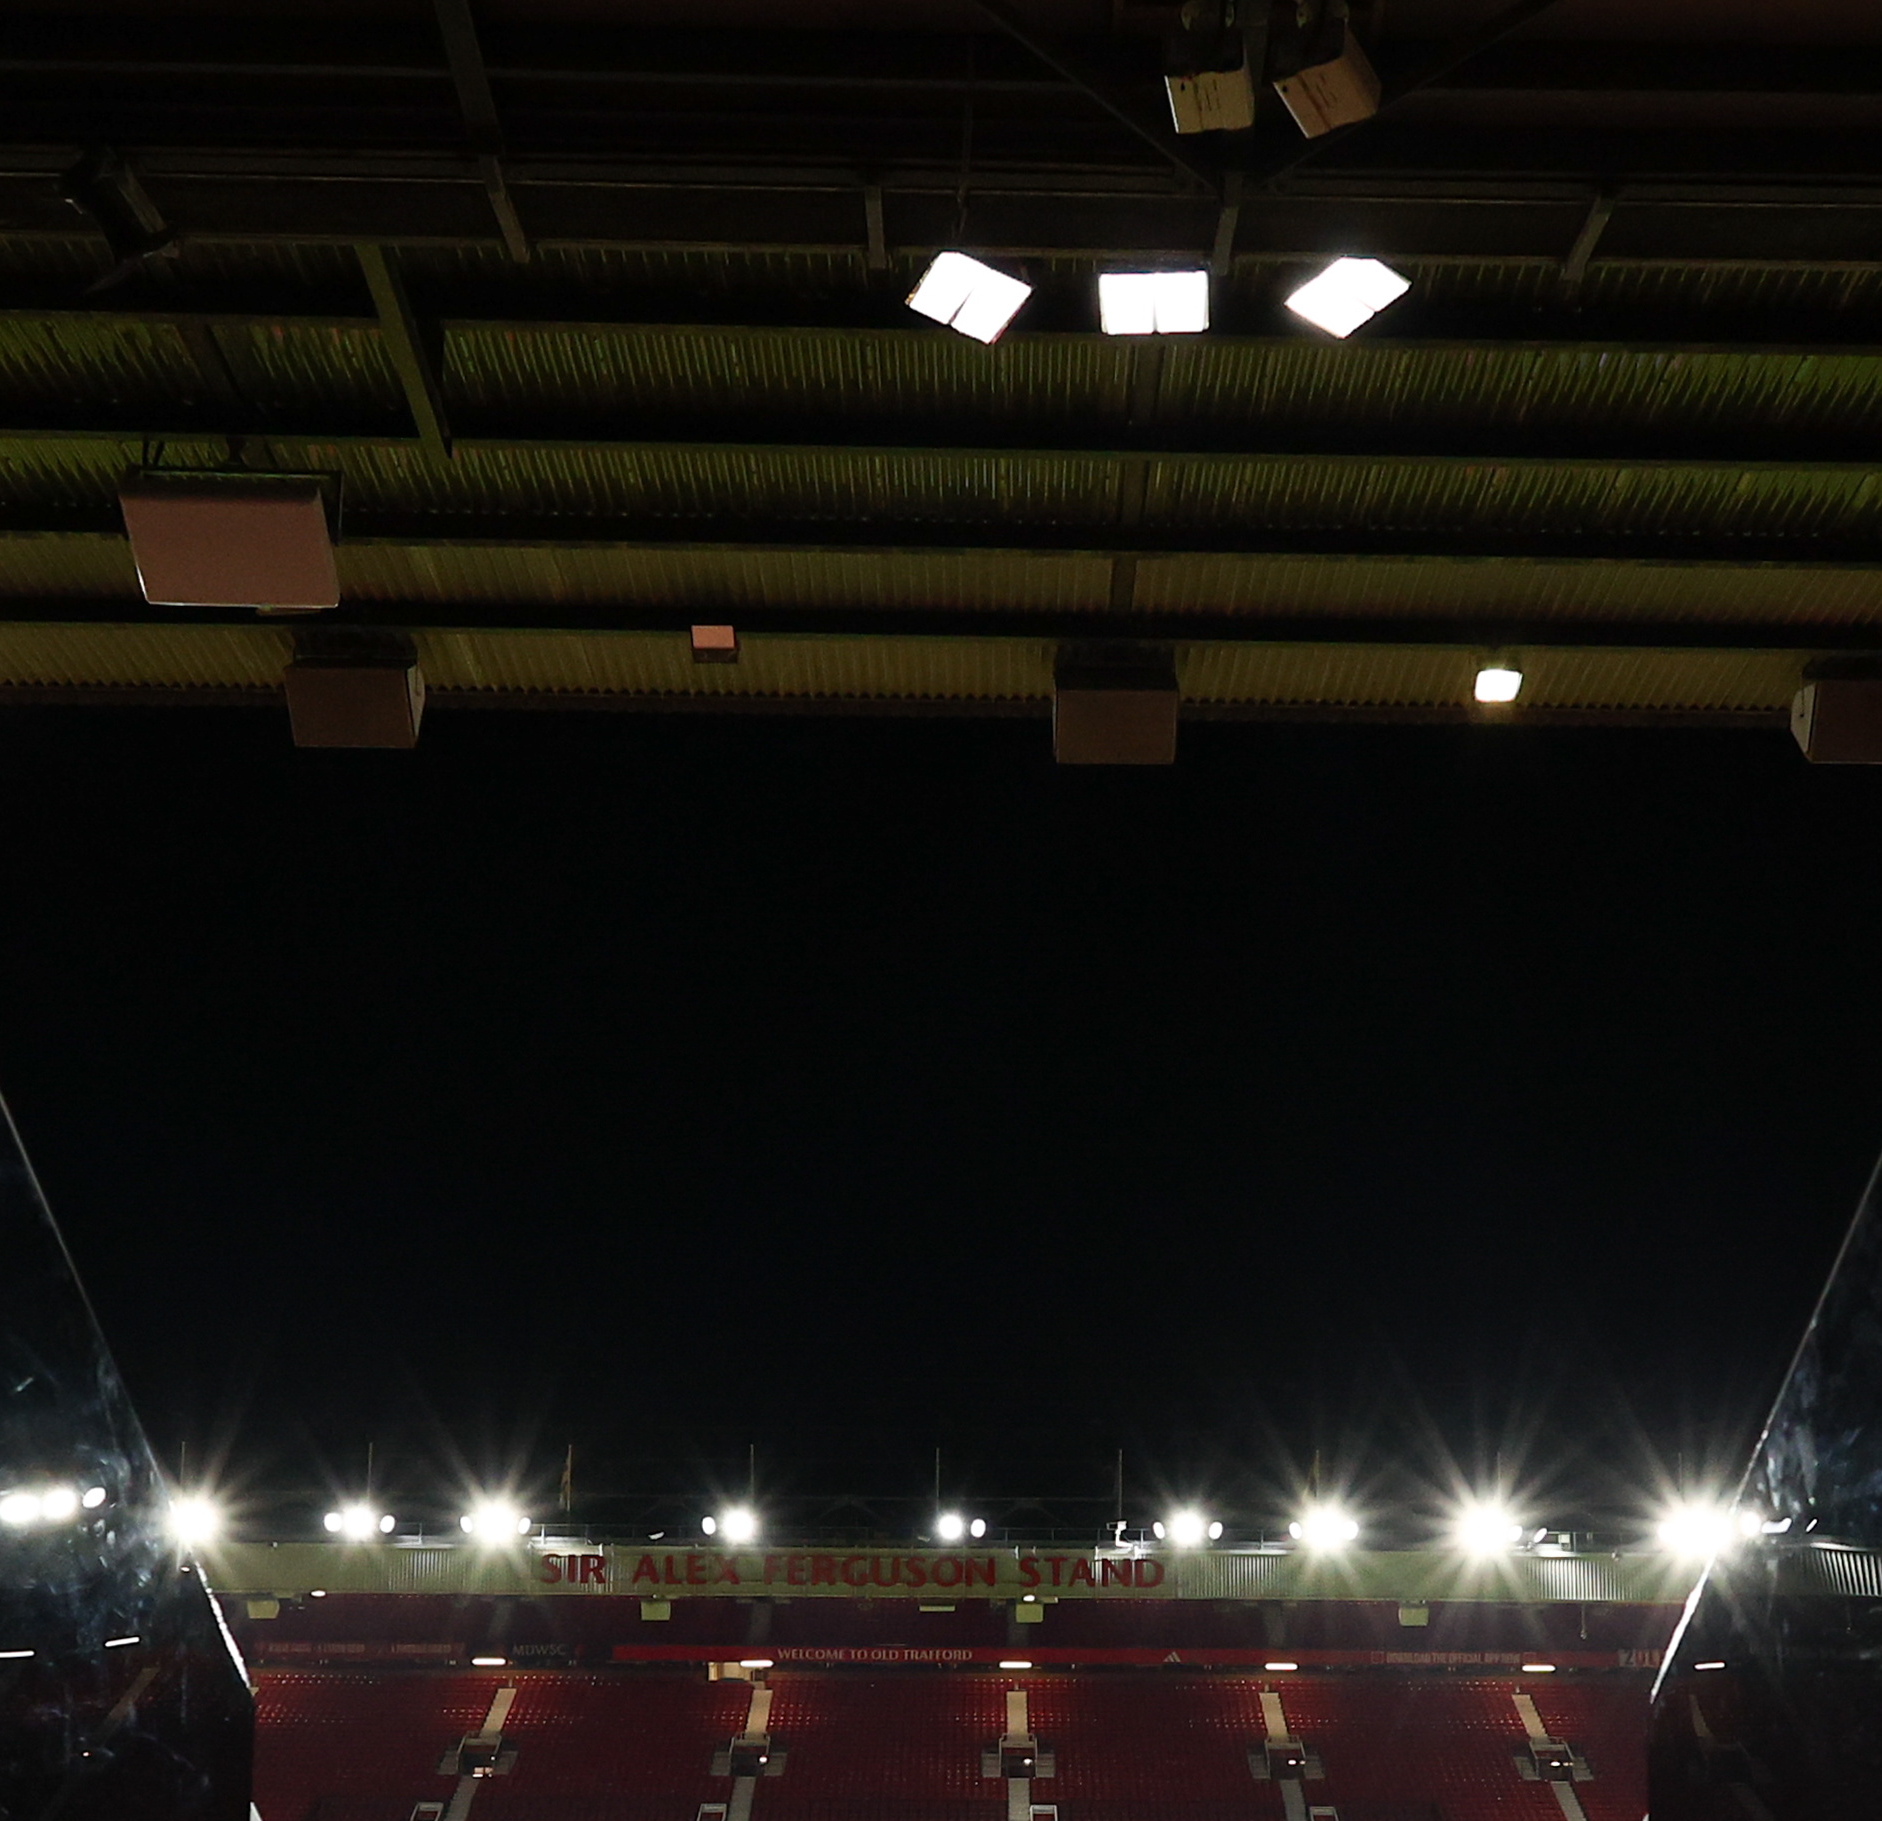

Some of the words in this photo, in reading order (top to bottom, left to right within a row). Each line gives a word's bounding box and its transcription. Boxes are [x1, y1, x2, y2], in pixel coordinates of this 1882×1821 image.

[540, 1553, 608, 1585] SIR
[632, 1554, 740, 1585] ALEX
[764, 1555, 997, 1587] FERGUSON
[1020, 1556, 1165, 1588] STAND
[777, 1648, 844, 1662] WELCOME
[847, 1648, 869, 1662] TO
[871, 1648, 900, 1662] OLD
[903, 1648, 973, 1662] TRAFFORD
